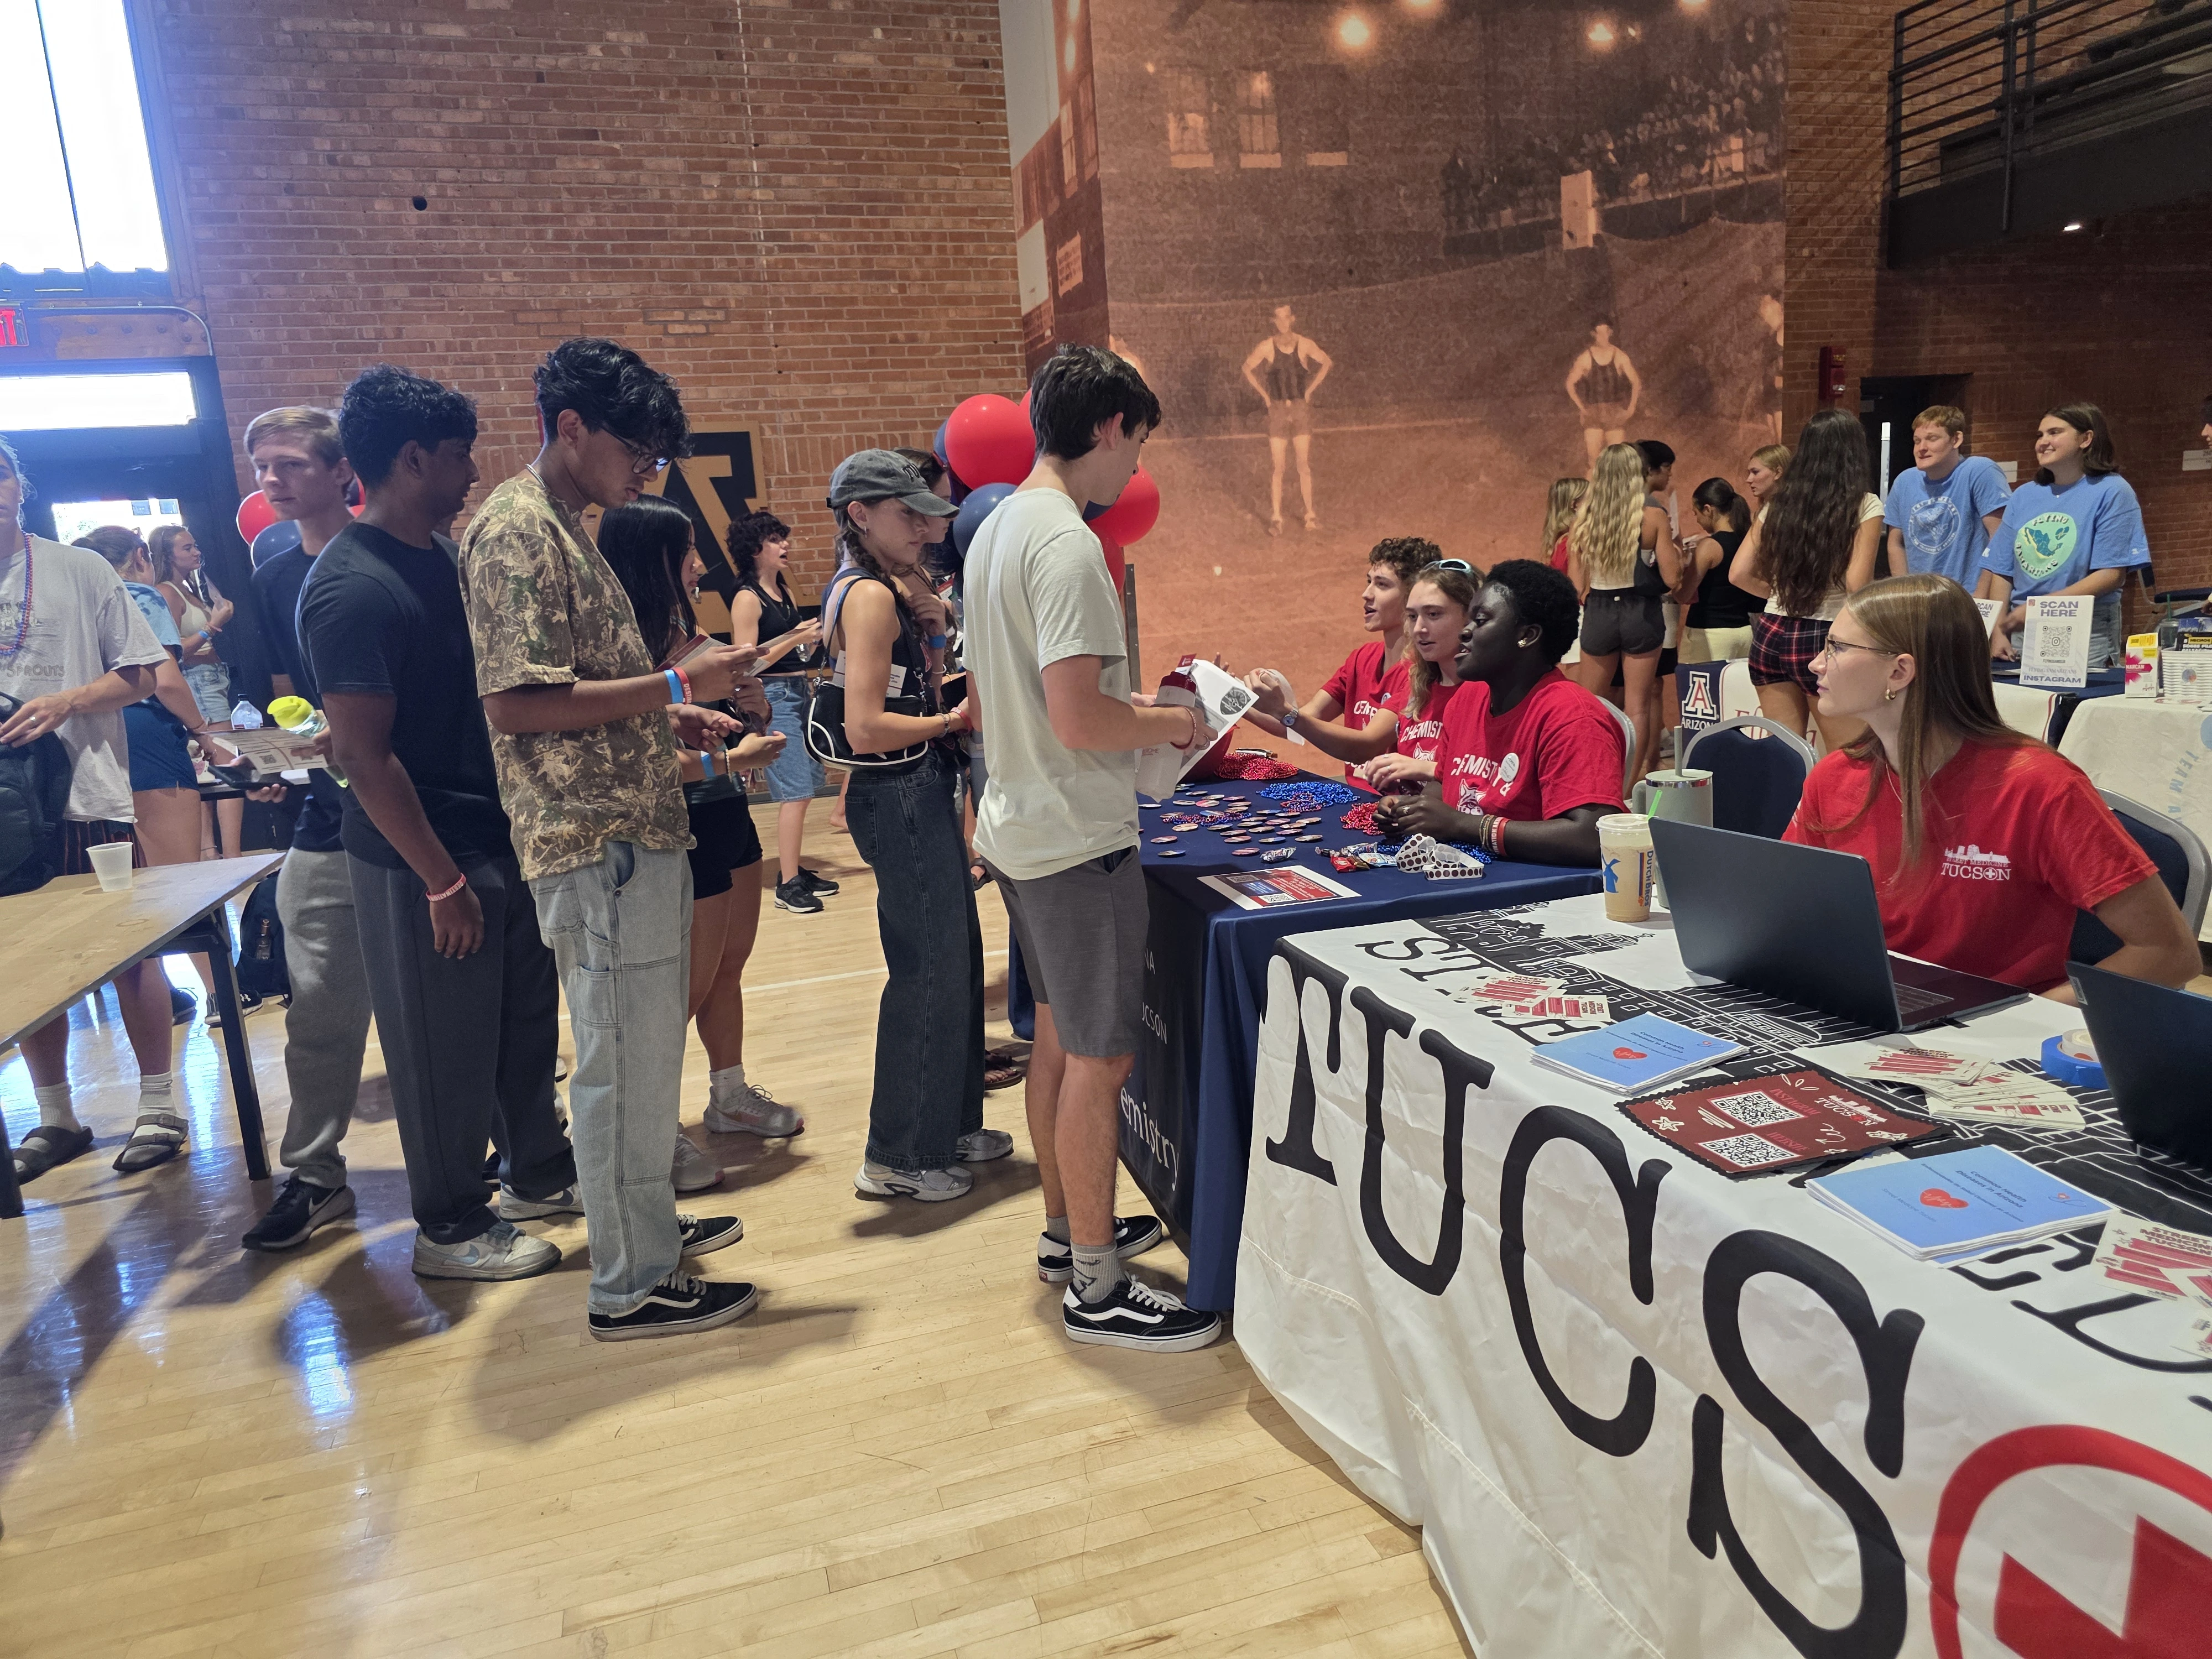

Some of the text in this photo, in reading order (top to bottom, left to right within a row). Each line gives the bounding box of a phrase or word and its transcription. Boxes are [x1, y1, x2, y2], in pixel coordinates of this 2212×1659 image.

[2039, 601, 2079, 609] SCAN
[2040, 609, 2077, 617] HERE
[7, 664, 65, 678] SPROUTS
[2023, 675, 2081, 684] INSTAGRAM
[1681, 717, 1717, 731] ARIZON
[1645, 850, 1654, 881] DUTCH
[1941, 863, 2011, 880] TUCSON
[1970, 859, 2008, 868] MEDICINE
[1630, 1032, 1656, 1044] Diseases
[1661, 1044, 1684, 1054] Arizona
[1639, 1031, 1685, 1050] Common Health
[1814, 1097, 1878, 1126] TUCSON
[1119, 1084, 1180, 1191] emistry
[1955, 1170, 1987, 1188] Diseases
[1994, 1191, 2023, 1208] Arizona
[1970, 1171, 2027, 1203] Common Health
[2139, 1228, 2212, 1250] MEDICIN
[2145, 1235, 2212, 1255] TUCSON
[2152, 1227, 2211, 1244] STREET
